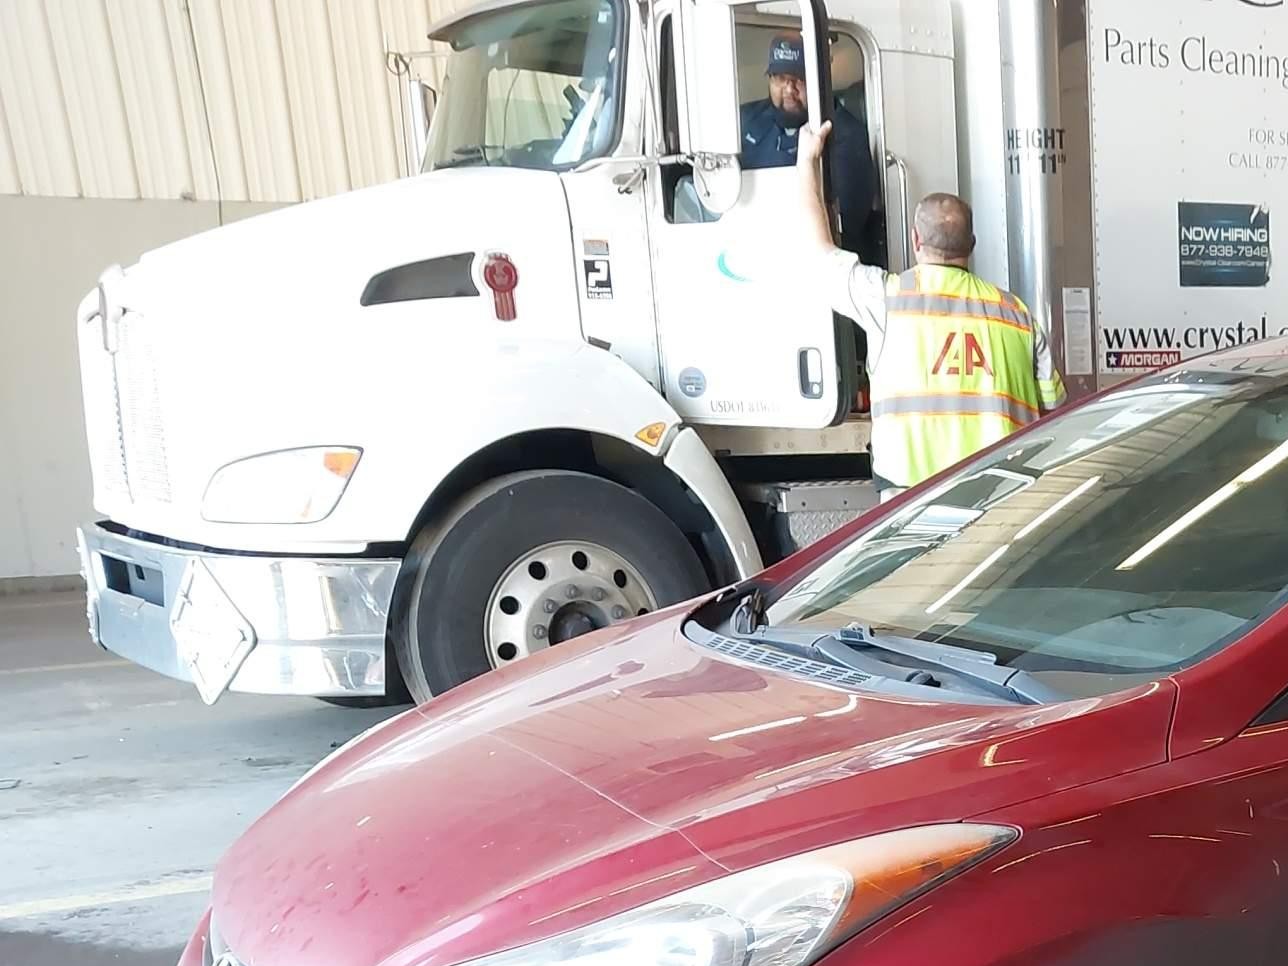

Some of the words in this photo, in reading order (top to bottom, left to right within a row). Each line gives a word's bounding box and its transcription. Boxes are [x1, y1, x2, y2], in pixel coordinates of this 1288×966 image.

[1104, 28, 1170, 69] Parts
[1007, 128, 1066, 150] HEIGHT
[1248, 127, 1275, 145] FOR
[1228, 152, 1260, 169] CALL
[1181, 226, 1219, 242] NOW
[1220, 227, 1268, 242] HIRING
[1181, 244, 1269, 258] 877-938-7948
[1120, 352, 1179, 367] MORGAN
